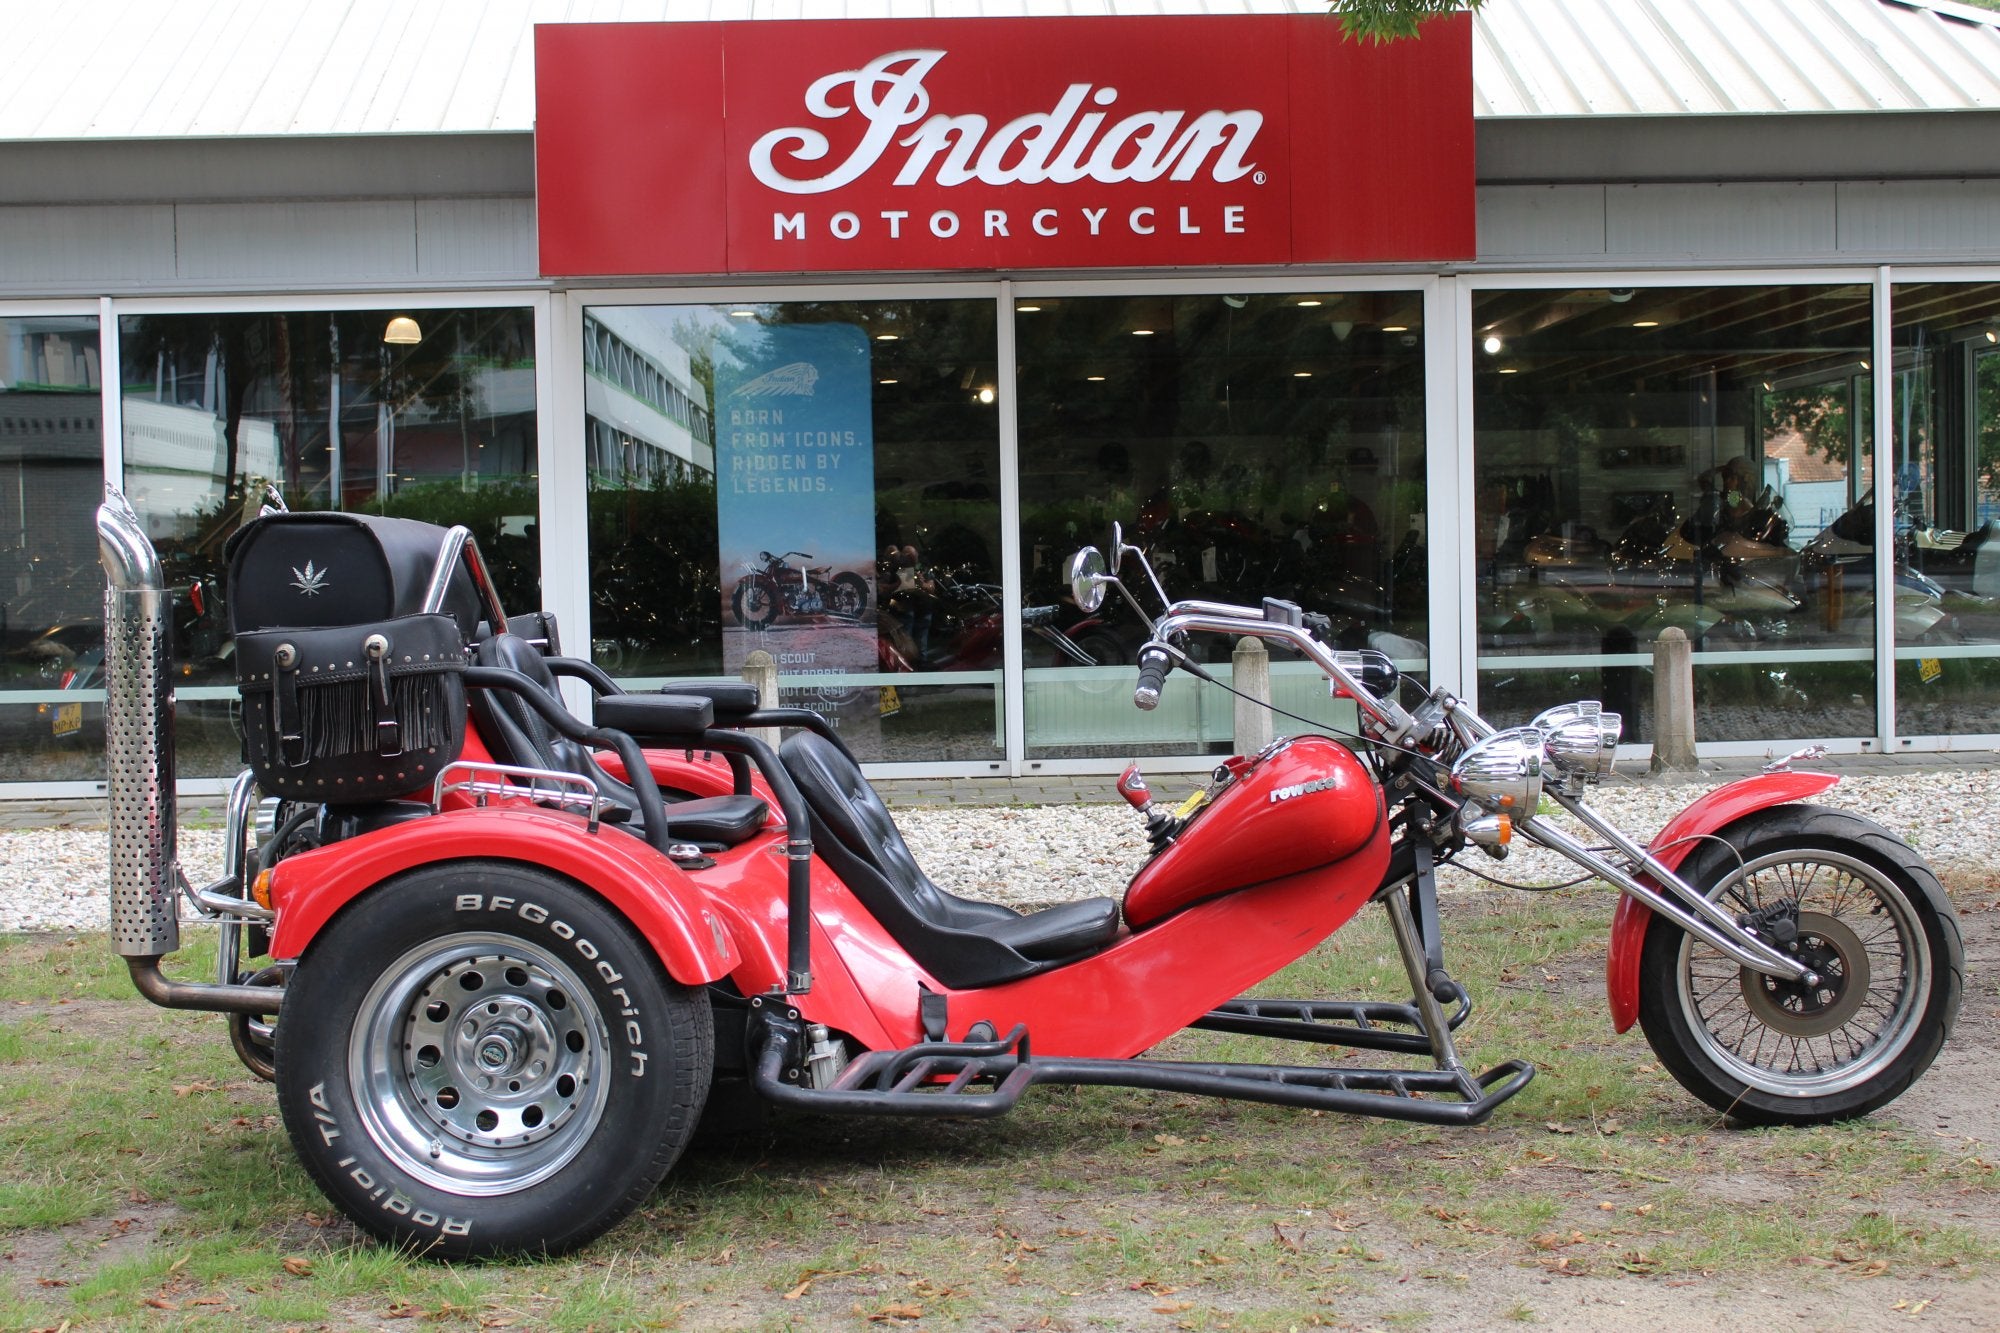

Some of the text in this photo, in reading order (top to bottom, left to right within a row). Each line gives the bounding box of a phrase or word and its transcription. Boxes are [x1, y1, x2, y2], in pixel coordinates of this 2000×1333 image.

[748, 49, 1264, 194] Indian
[773, 204, 1246, 241] MOTORCYCLE
[731, 409, 783, 425] BORN
[732, 430, 862, 448] FROM ICONS.
[733, 454, 840, 471] RIDDEN BY
[734, 476, 834, 494] LEGENDS.
[780, 652, 816, 664] SCOUT
[455, 894, 648, 1078] BFGoodrich
[310, 1082, 473, 1236] Radial T/A
